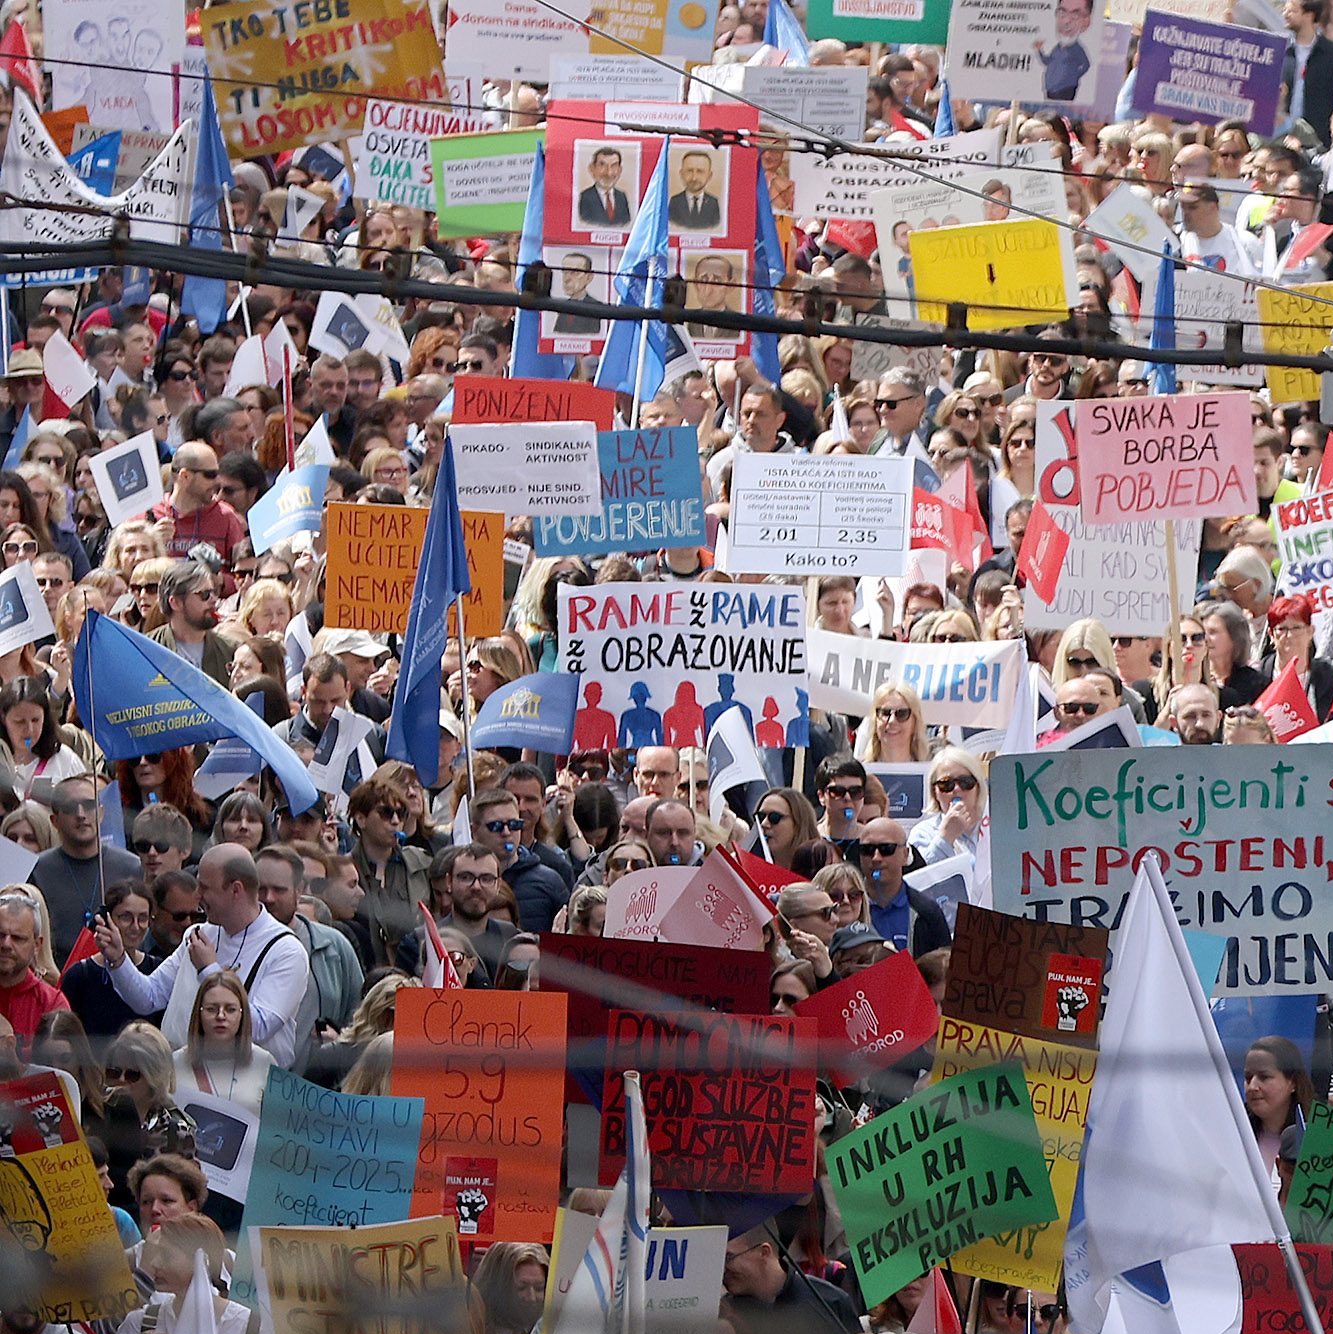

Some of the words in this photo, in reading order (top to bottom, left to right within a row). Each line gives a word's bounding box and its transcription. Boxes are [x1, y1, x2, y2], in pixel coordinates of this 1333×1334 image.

[212, 14, 264, 50] TKO
[272, 0, 350, 34] TEBE
[284, 9, 428, 67] KRITIKOM
[230, 88, 260, 114] TI
[239, 100, 337, 148] LOŠOM
[1092, 401, 1175, 436] SVAKA
[1187, 400, 1221, 430] JE
[525, 453, 588, 464] AKTIVNOST
[1124, 434, 1219, 466] BORBA
[528, 484, 551, 494] NIJE
[528, 495, 591, 506] AKTIVNOST
[1095, 466, 1248, 516] POBJEDA
[785, 552, 827, 567] Kako
[832, 554, 858, 568] to?
[569, 591, 686, 634] RAME
[711, 591, 801, 630] RAME
[601, 632, 805, 675] OBRAZOVANJE
[1014, 757, 1310, 848] Koeficijenti
[423, 994, 534, 1051] Članak
[835, 1073, 1022, 1189] INKLUZIJA
[882, 1174, 905, 1208] U
[924, 1136, 965, 1184] RH
[856, 1166, 1034, 1275] EKSKLUZIJA
